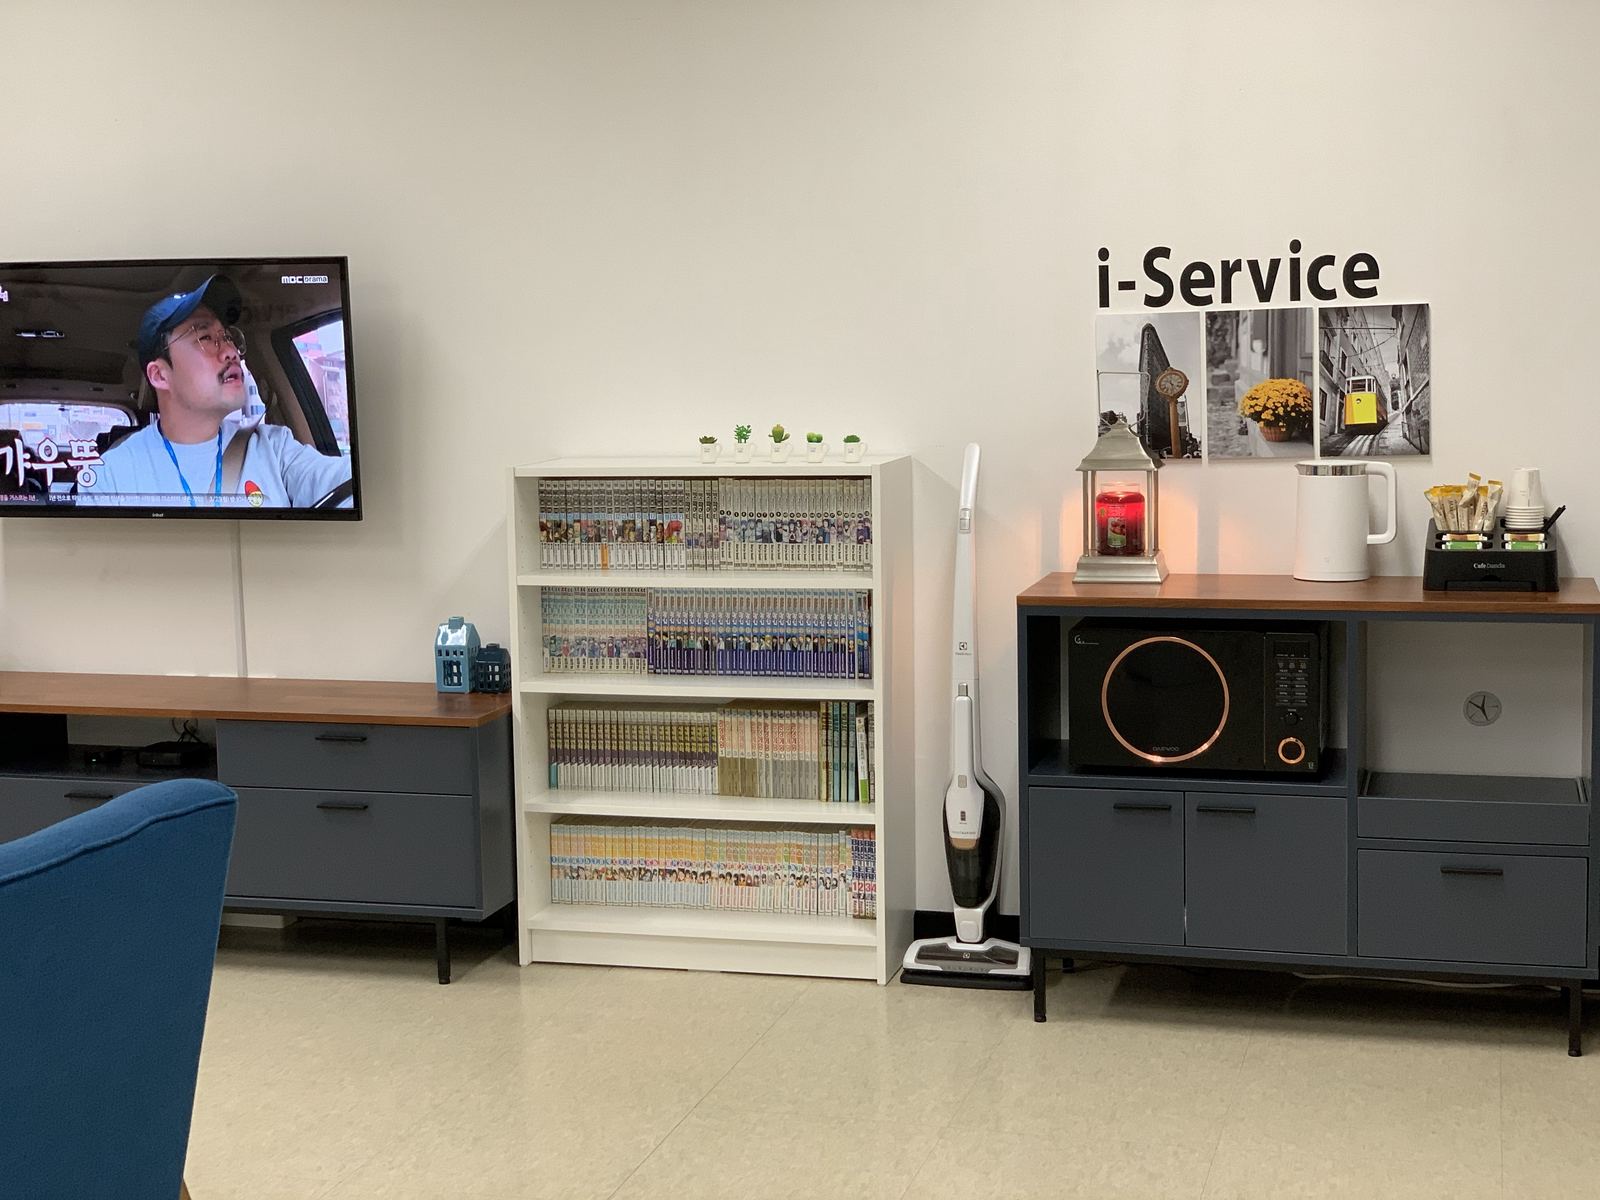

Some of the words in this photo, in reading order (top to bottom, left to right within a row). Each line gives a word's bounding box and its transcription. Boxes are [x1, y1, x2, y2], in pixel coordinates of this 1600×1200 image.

[1097, 239, 1380, 308] i-Service
[0, 437, 105, 488] 갸우뚱
[858, 882, 863, 891] 2
[865, 883, 871, 892] 3
